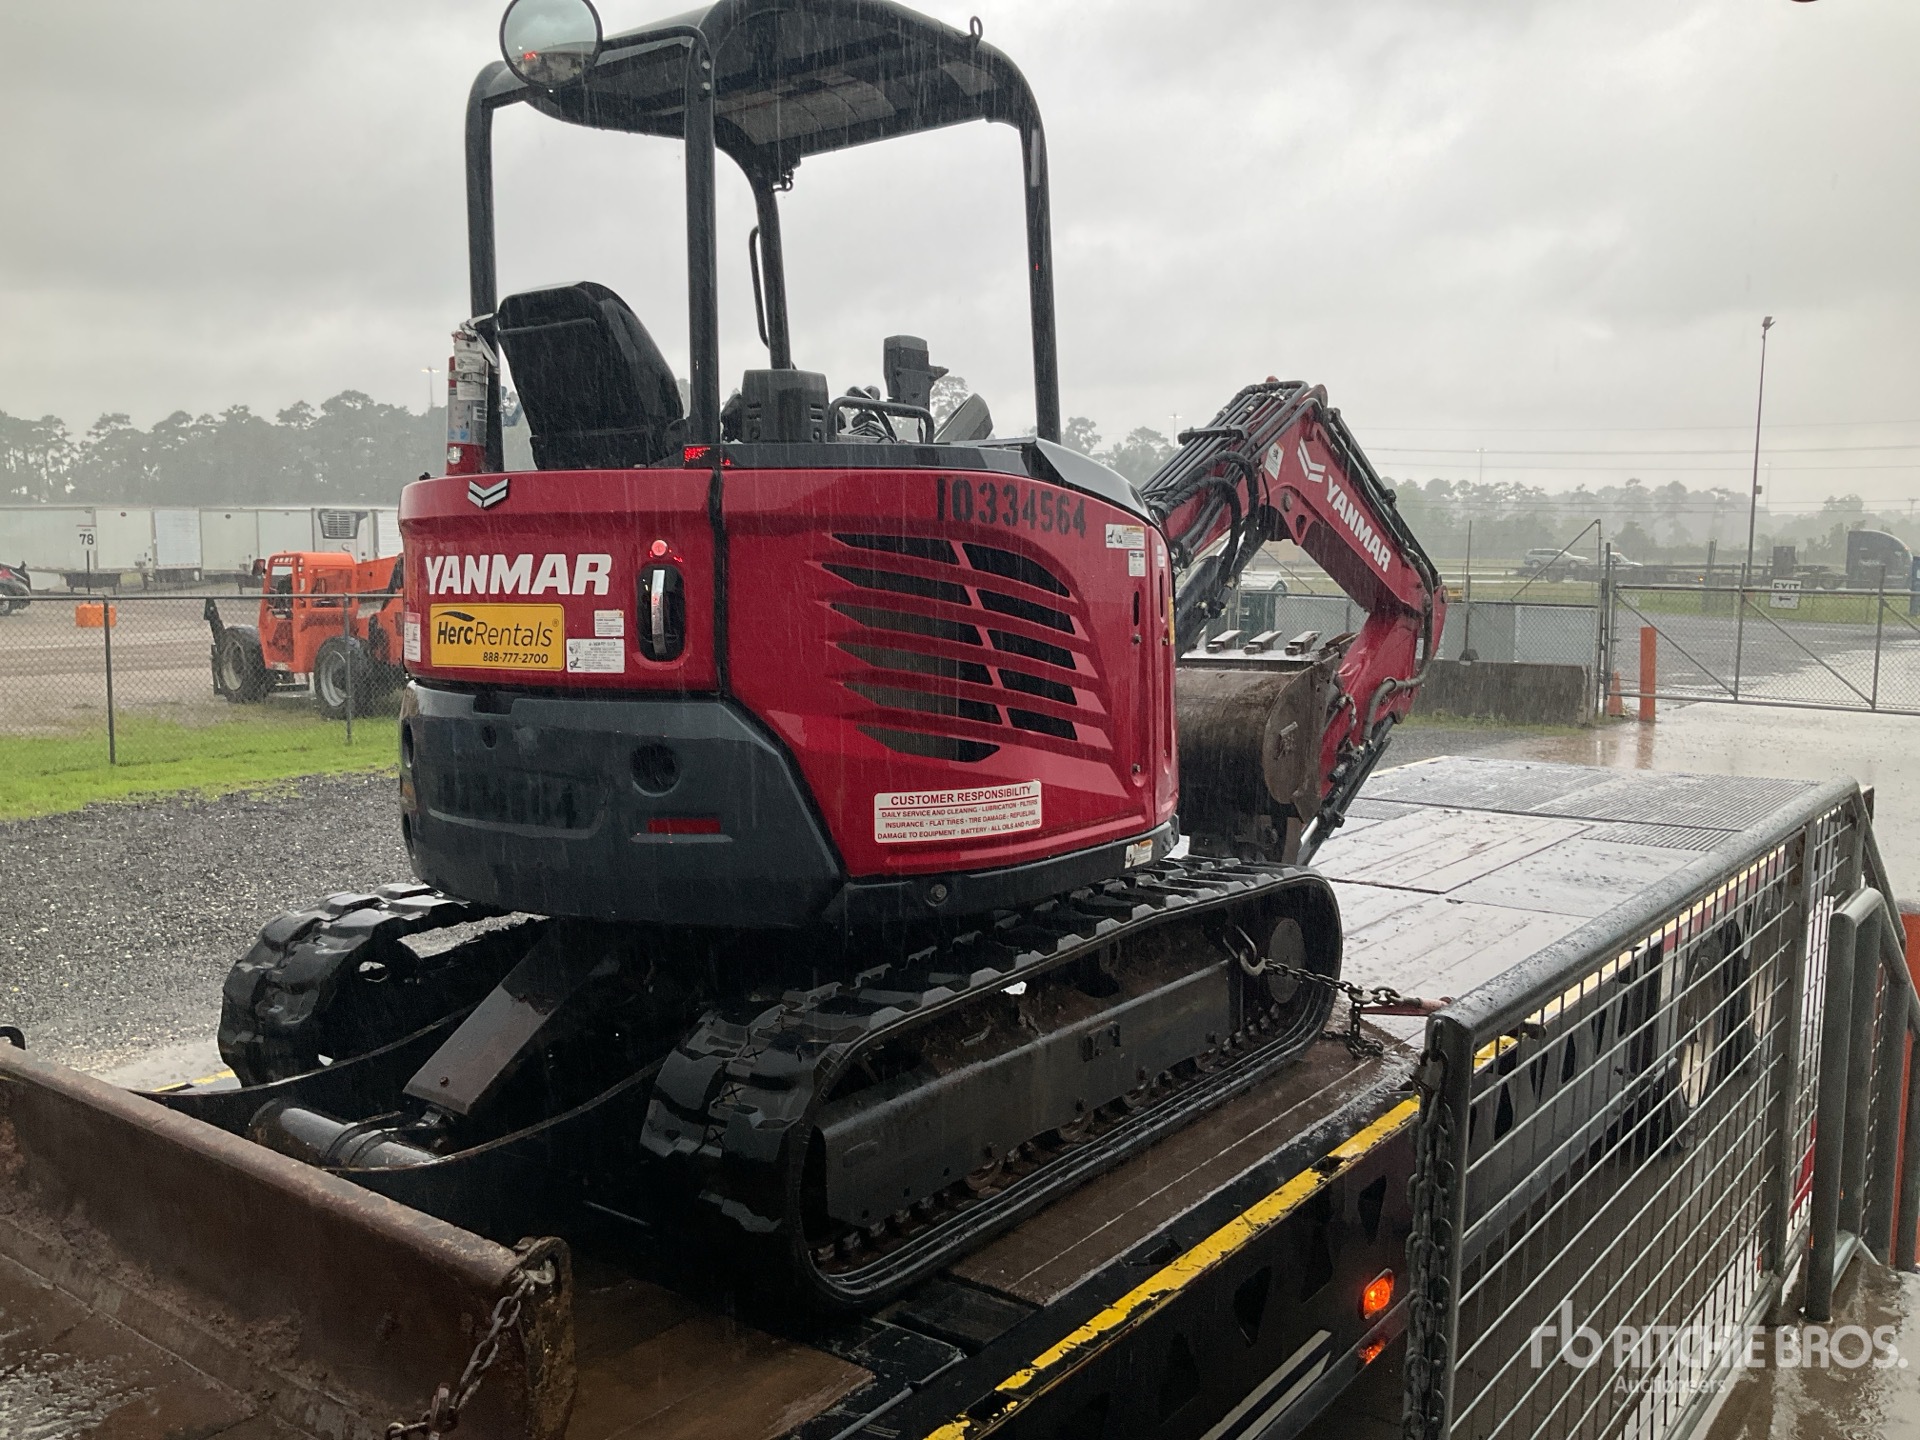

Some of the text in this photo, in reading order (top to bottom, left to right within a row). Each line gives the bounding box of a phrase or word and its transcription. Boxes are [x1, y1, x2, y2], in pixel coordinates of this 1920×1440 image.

[937, 478, 1086, 538] 10334564
[1325, 475, 1392, 572] YANMAR
[79, 533, 94, 545] 78
[425, 553, 612, 595] YANMAR
[483, 651, 549, 664] 888-777-2700
[891, 785, 1031, 806] CUSTOMER RESPONSIBILITY
[902, 809, 931, 817] SERVICE
[946, 806, 978, 815] CLEANING
[981, 803, 1017, 812] LUBRICATION
[1020, 799, 1038, 807] FILTERS
[877, 832, 908, 840] DAMAGE
[919, 829, 956, 838] EQUIPMENT
[960, 826, 988, 835] BATTERY
[1002, 823, 1014, 831] OILS
[1025, 818, 1041, 827] FLUIDS
[885, 820, 925, 829] INSURANCE
[929, 819, 945, 827] FLAT
[982, 813, 1006, 822] DAMAGE
[1009, 809, 1036, 819] REFUELING
